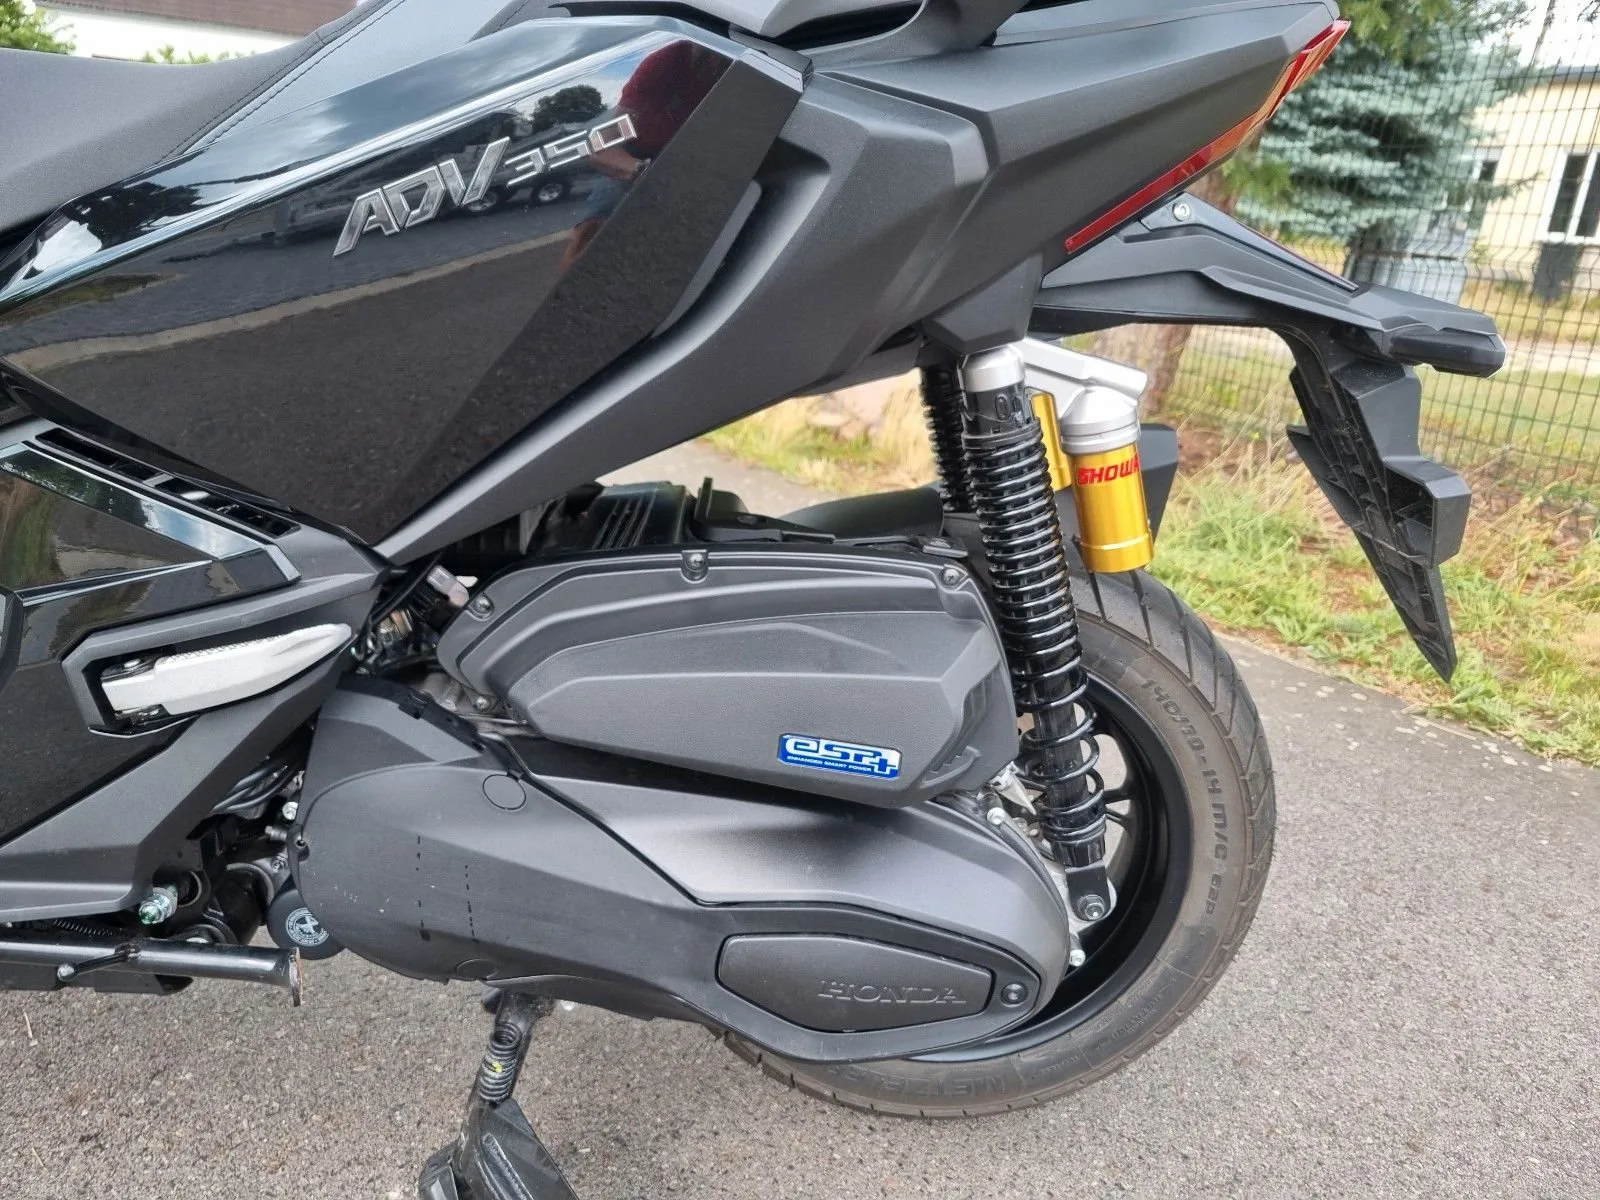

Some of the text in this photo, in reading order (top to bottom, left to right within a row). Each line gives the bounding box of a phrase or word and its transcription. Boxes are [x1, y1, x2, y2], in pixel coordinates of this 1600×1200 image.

[786, 755, 872, 773] ENHANCED SMART POWER
[817, 980, 967, 1004] HONDA
